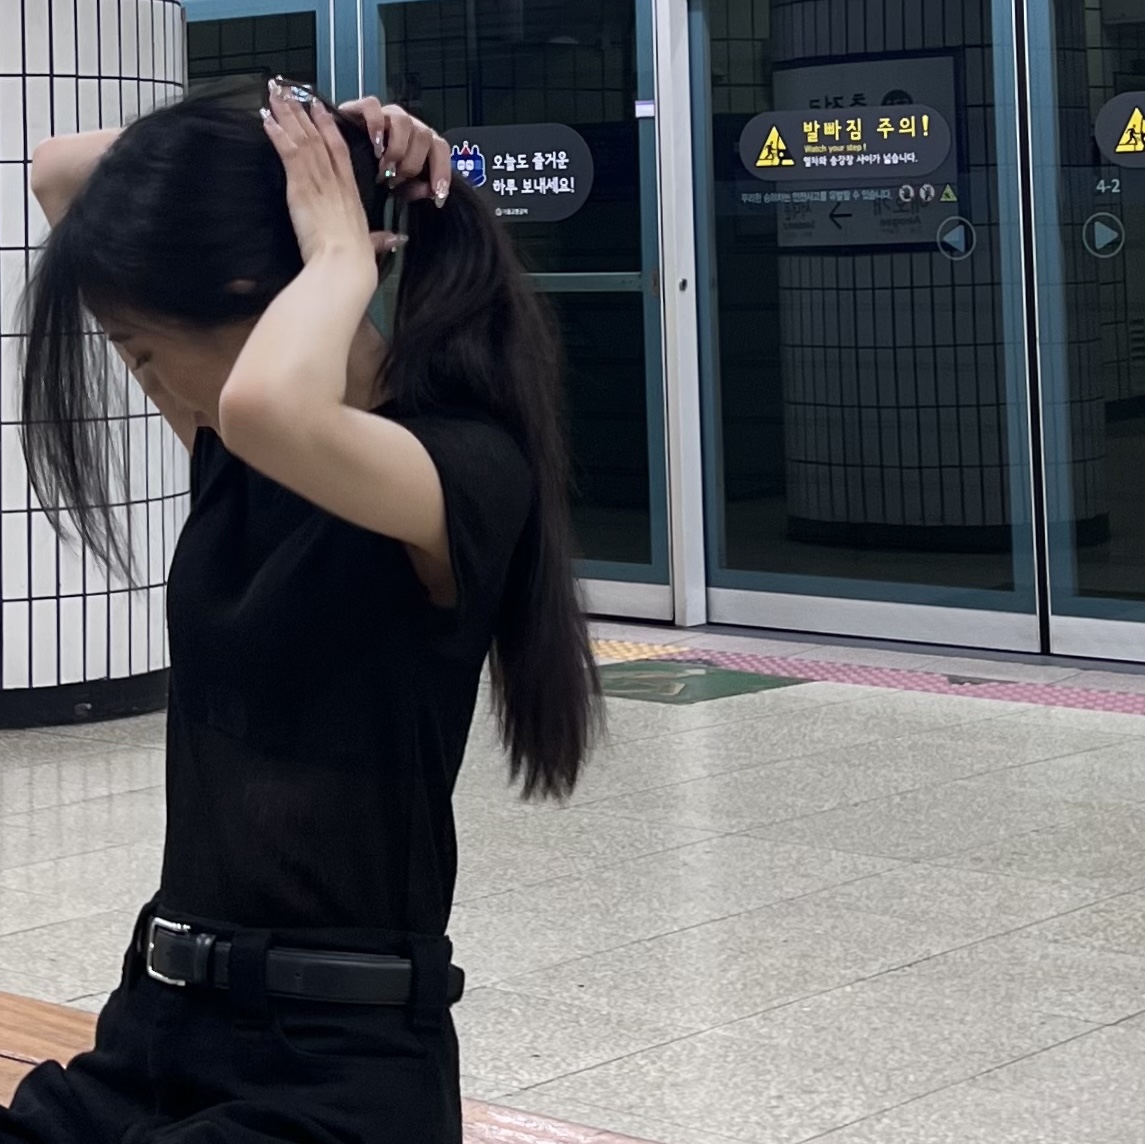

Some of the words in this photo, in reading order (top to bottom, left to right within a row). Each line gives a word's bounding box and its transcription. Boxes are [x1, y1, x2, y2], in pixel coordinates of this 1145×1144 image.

[803, 118, 862, 143] 발빠짐
[876, 115, 929, 140] 주의!
[804, 145, 827, 153] Watch
[829, 145, 845, 154] your
[492, 153, 529, 172] 오늘도
[531, 151, 569, 170] 즐거운
[829, 155, 854, 166] 승강장
[856, 153, 881, 165] 사이가
[883, 152, 918, 164] 넓습니다.
[492, 178, 518, 196] 하루
[521, 176, 575, 195] 보내세요!
[1096, 179, 1121, 193] 4-2
